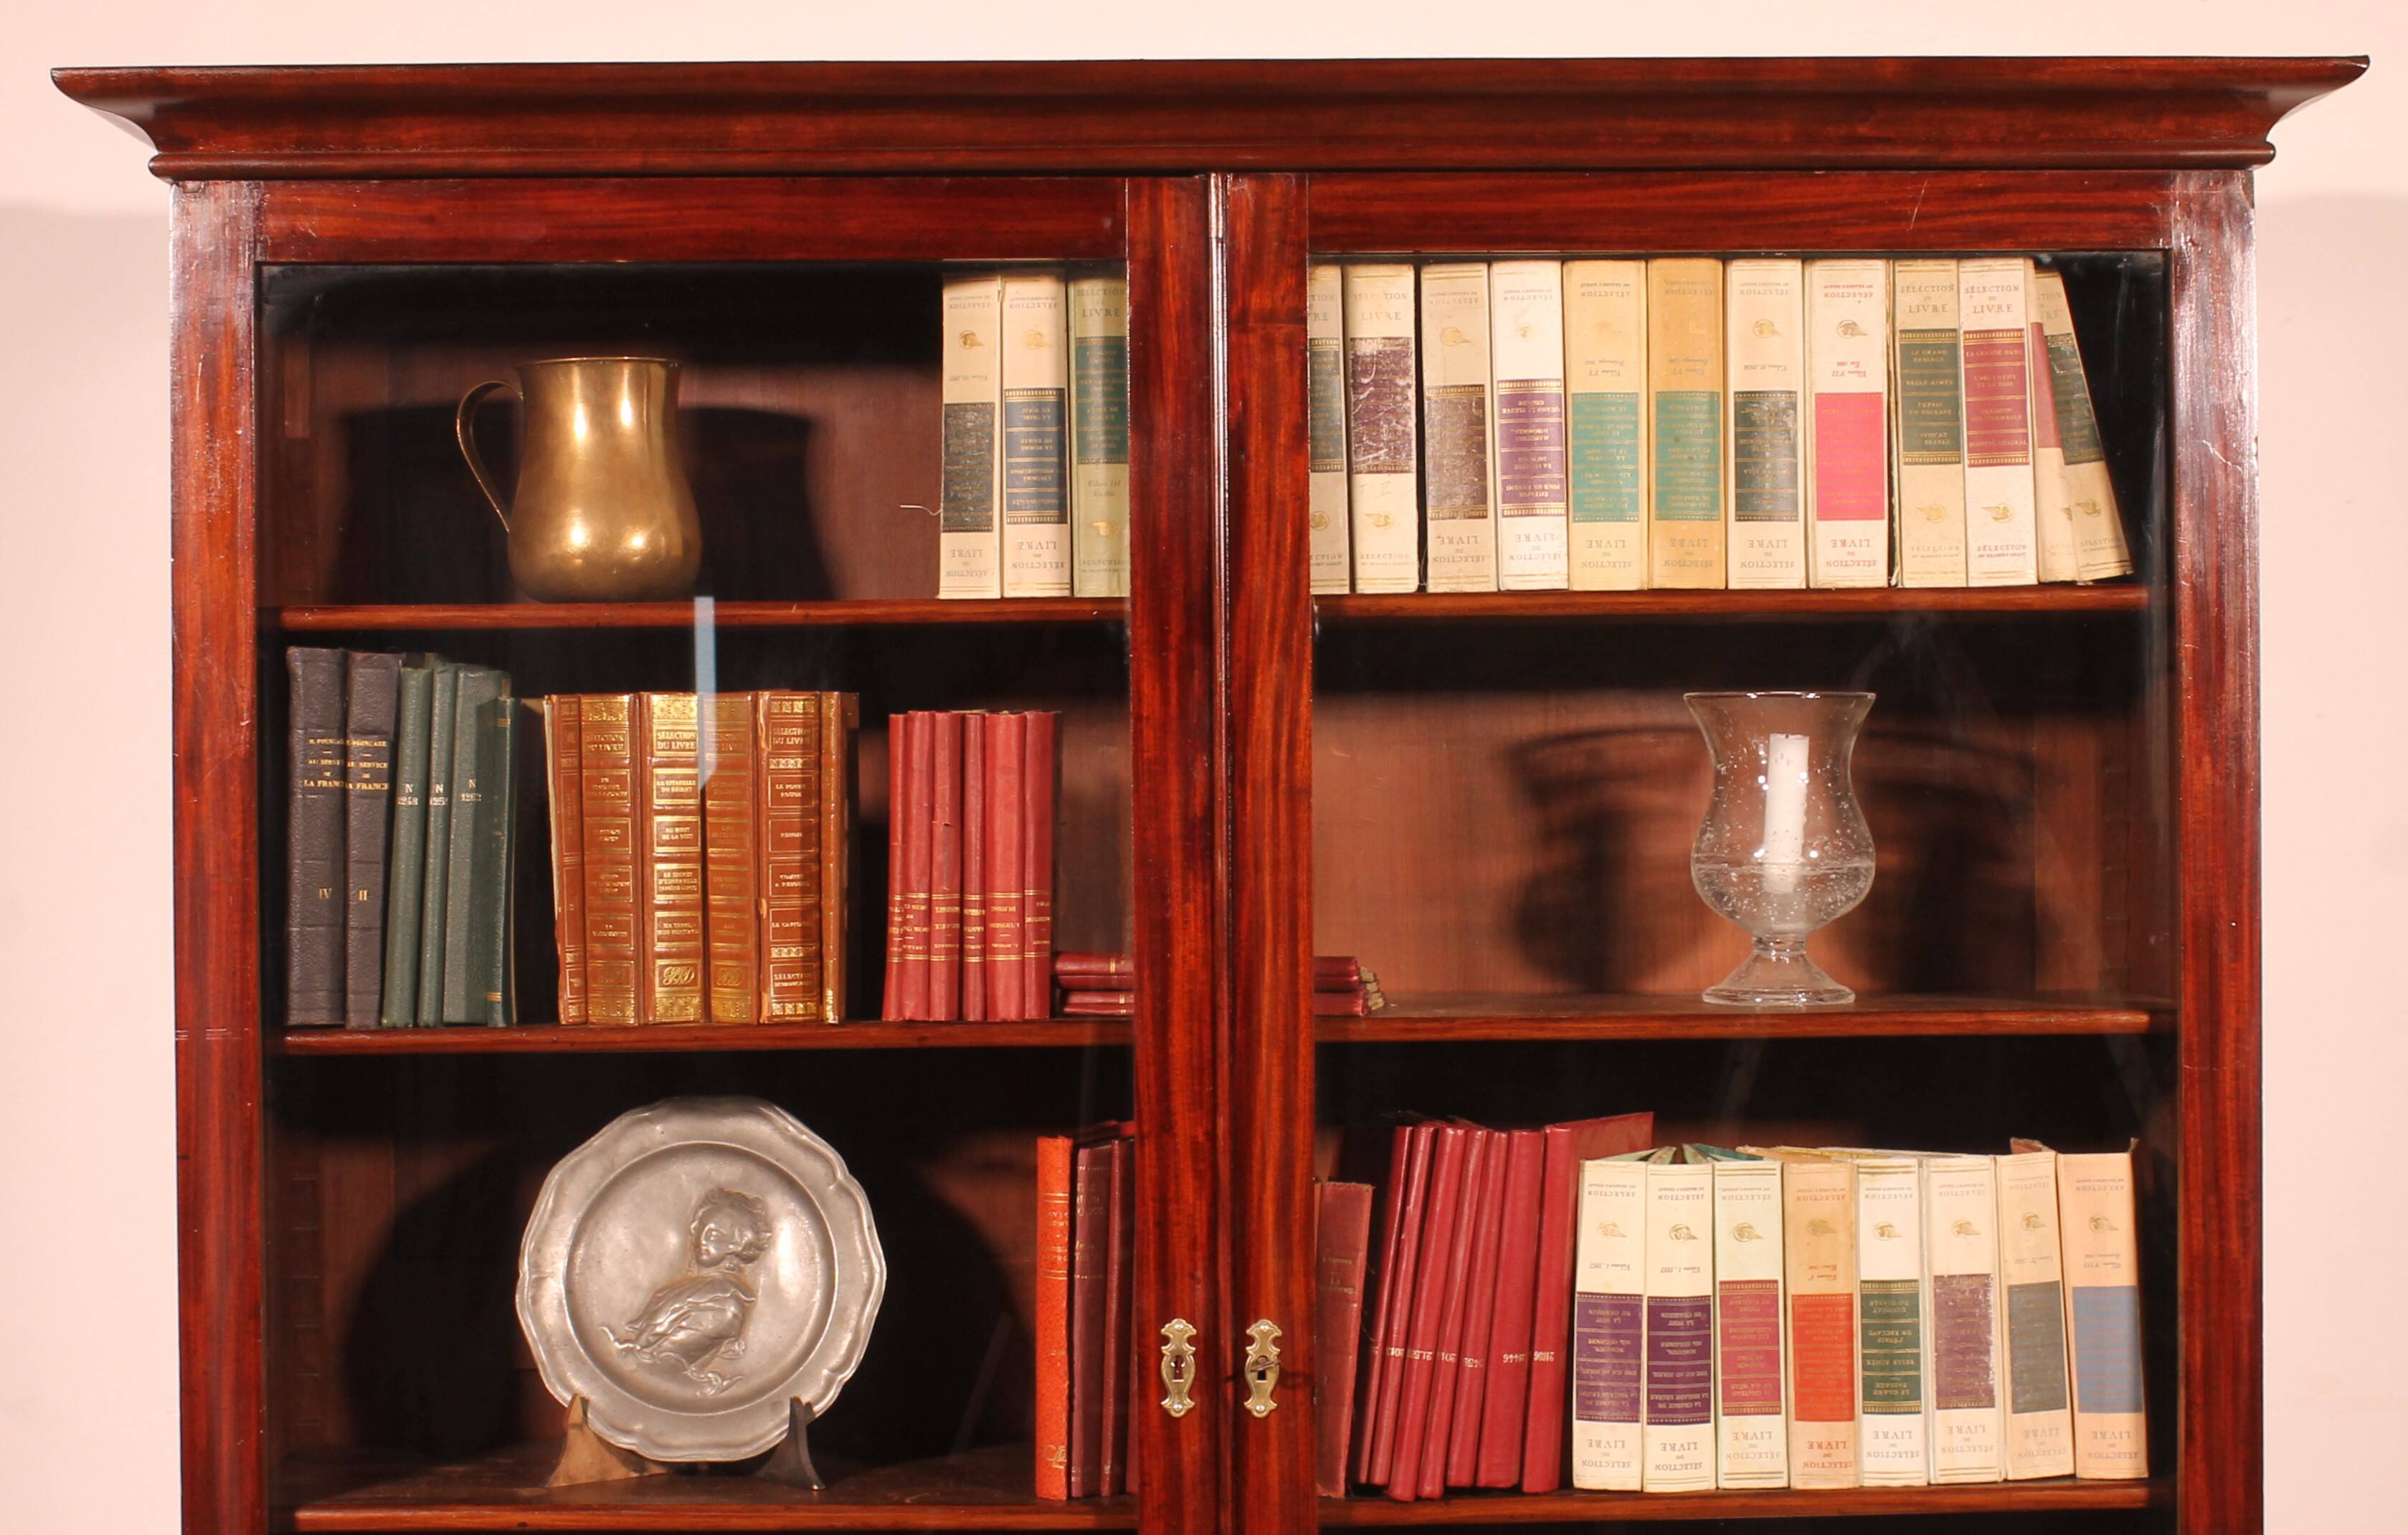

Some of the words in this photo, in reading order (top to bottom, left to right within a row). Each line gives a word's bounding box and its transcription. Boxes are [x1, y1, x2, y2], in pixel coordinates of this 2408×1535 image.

[1909, 304, 1948, 313] LIVRE
[1973, 304, 2013, 314] LIVRE
[1440, 536, 1478, 544] LIVRE
[1515, 533, 1554, 542] LIVRE
[1018, 541, 1057, 551] LIVRE
[1586, 540, 1626, 548] LIVRE
[1669, 539, 1707, 548] LIVRE
[1748, 540, 1787, 548] LIVRE
[1830, 539, 1871, 548] LIVRE
[950, 549, 983, 559] LIVRE
[658, 741, 673, 750] DU
[674, 741, 696, 750] LIVRE
[356, 782, 389, 791] FRANCE
[404, 783, 414, 793] N
[435, 783, 444, 794] N
[468, 778, 476, 789] N
[318, 888, 332, 900] IV
[359, 889, 369, 901] II
[1872, 1430, 1912, 1440] LIVRE
[1946, 1425, 1986, 1435] LIVRE
[2024, 1428, 2058, 1439] LIVRE
[1732, 1431, 1771, 1441] LIVRE
[1586, 1439, 1626, 1448] LIVRE
[1660, 1442, 1697, 1452] LIVRE
[1807, 1441, 1847, 1450] LIVRE
